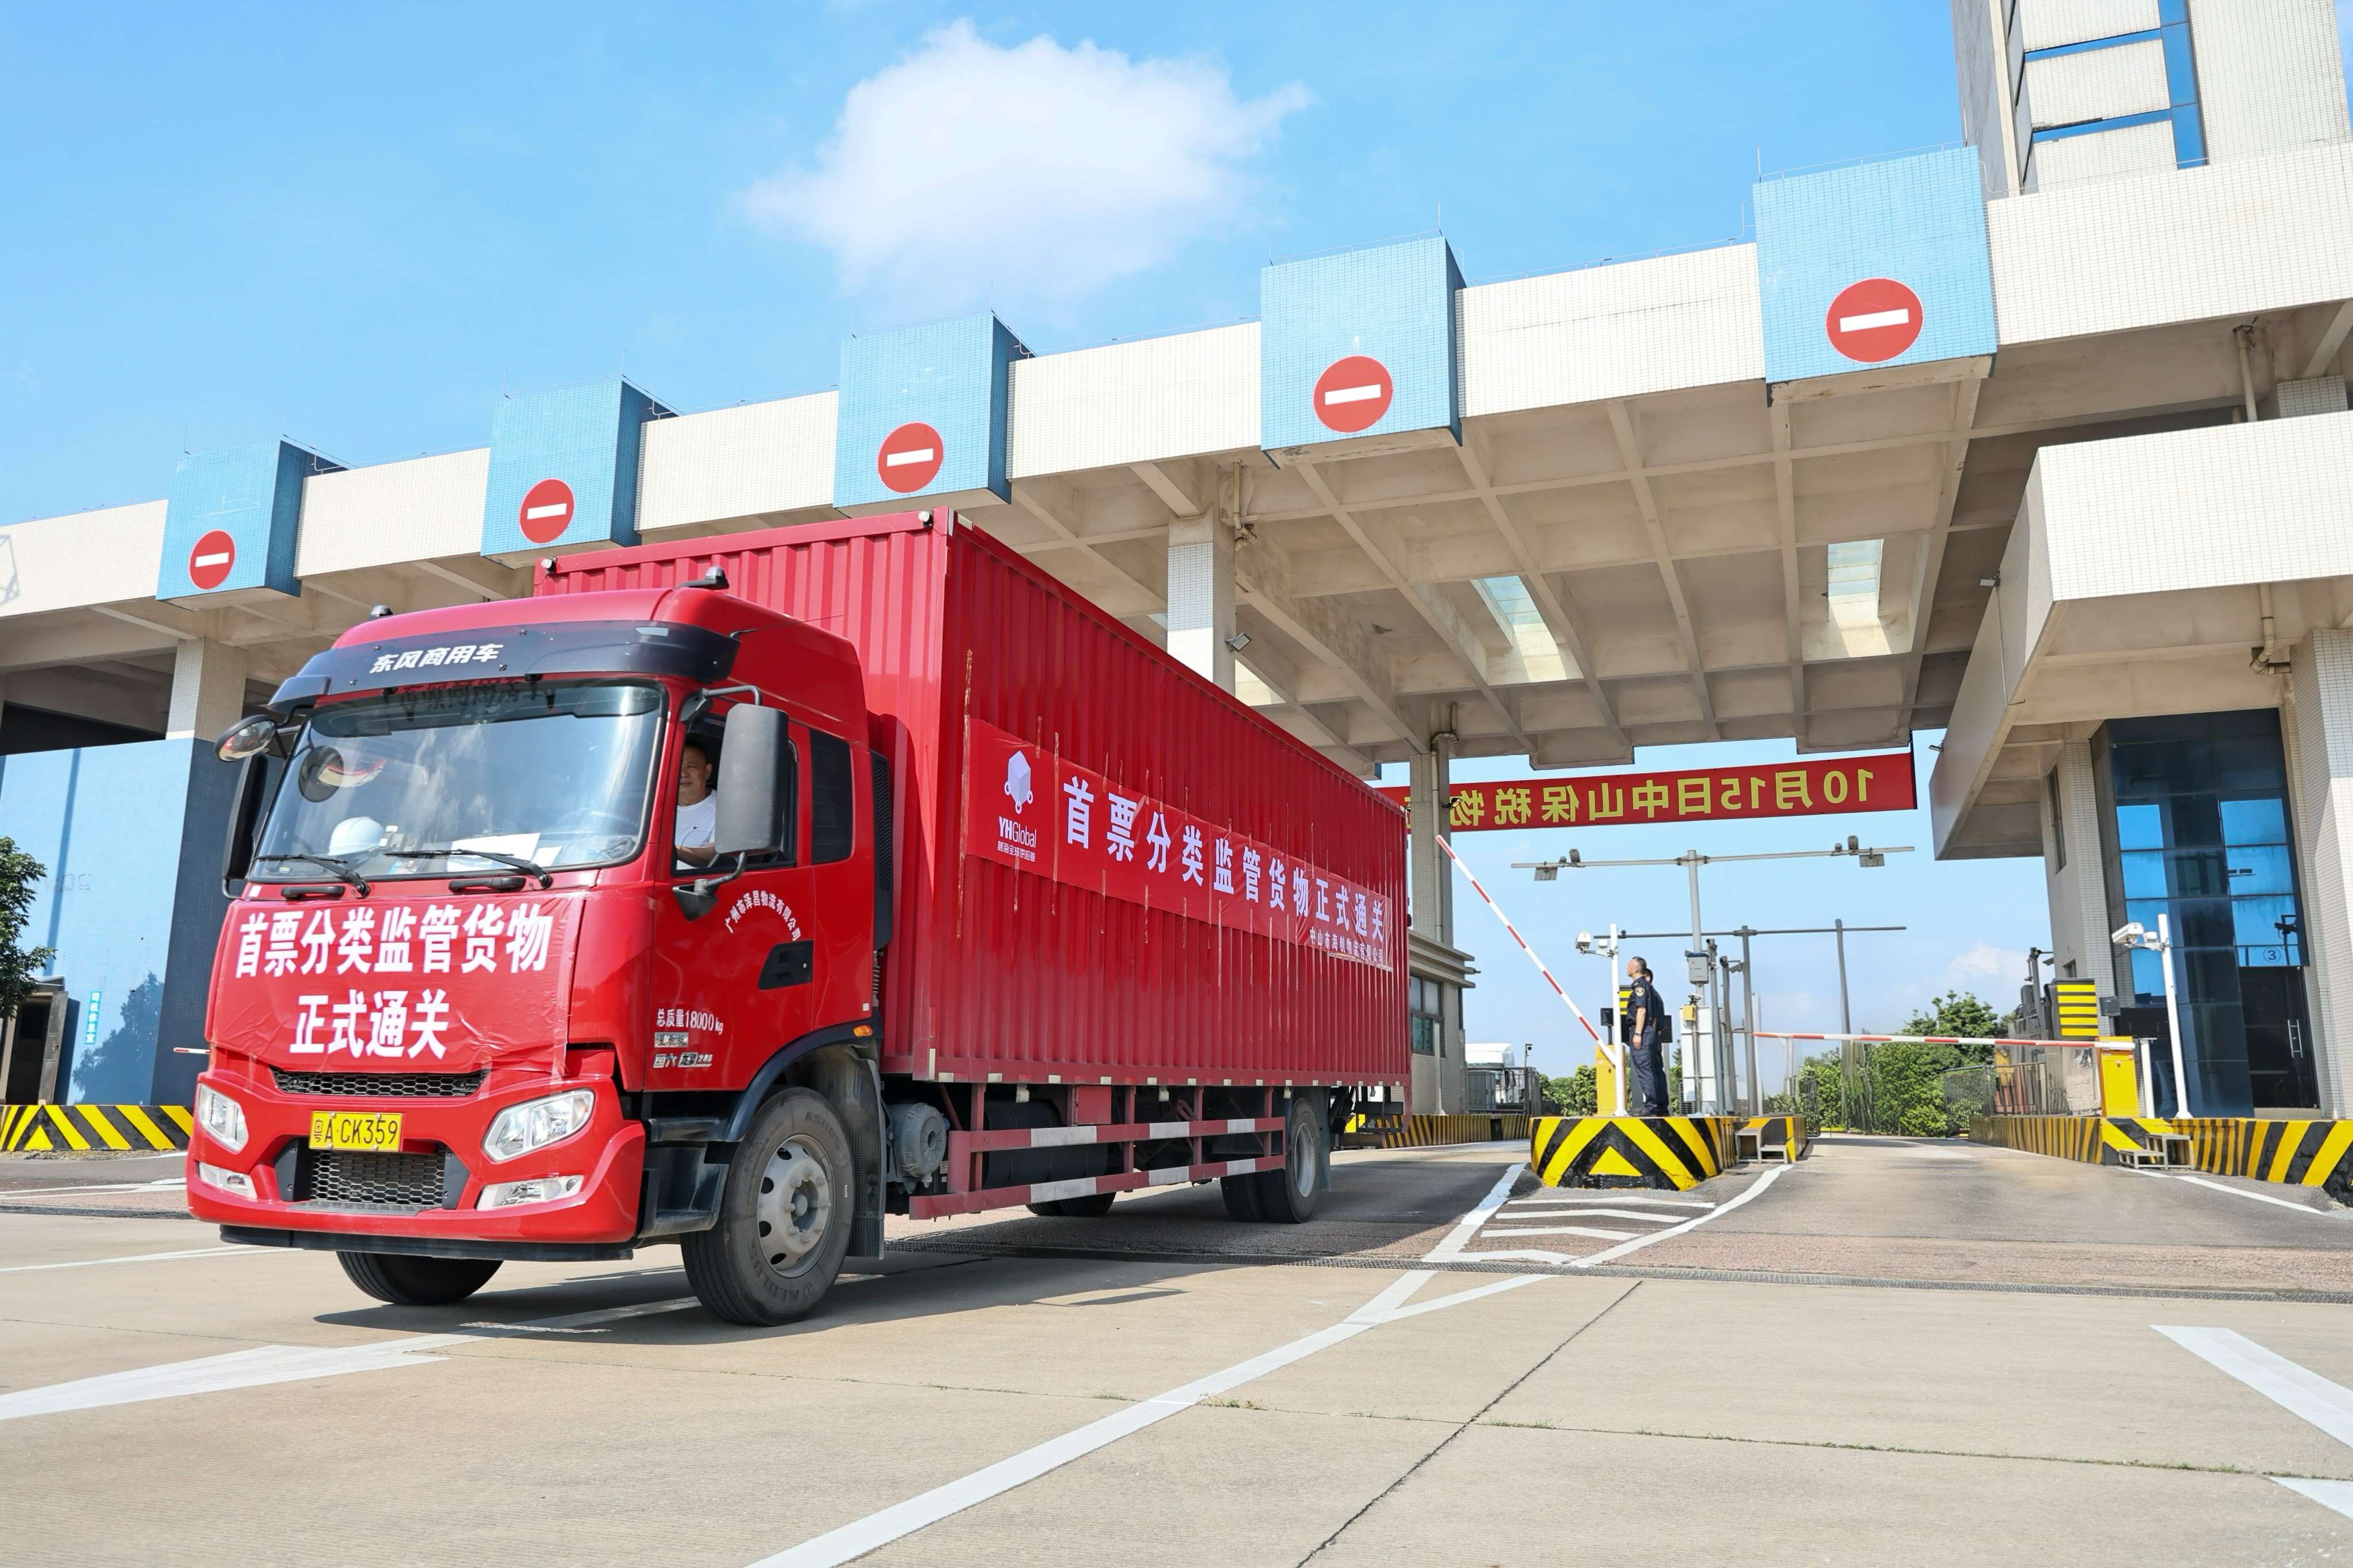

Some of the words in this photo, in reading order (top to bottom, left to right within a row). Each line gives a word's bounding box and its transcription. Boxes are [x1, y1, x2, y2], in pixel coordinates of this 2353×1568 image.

[369, 643, 504, 674] 东风商用车
[998, 816, 1036, 848] YHGlobal
[1063, 776, 1383, 943] 首票分类监管货物正式通关
[235, 903, 553, 978] 首票分类监管货物
[288, 989, 450, 1060] 正式通关
